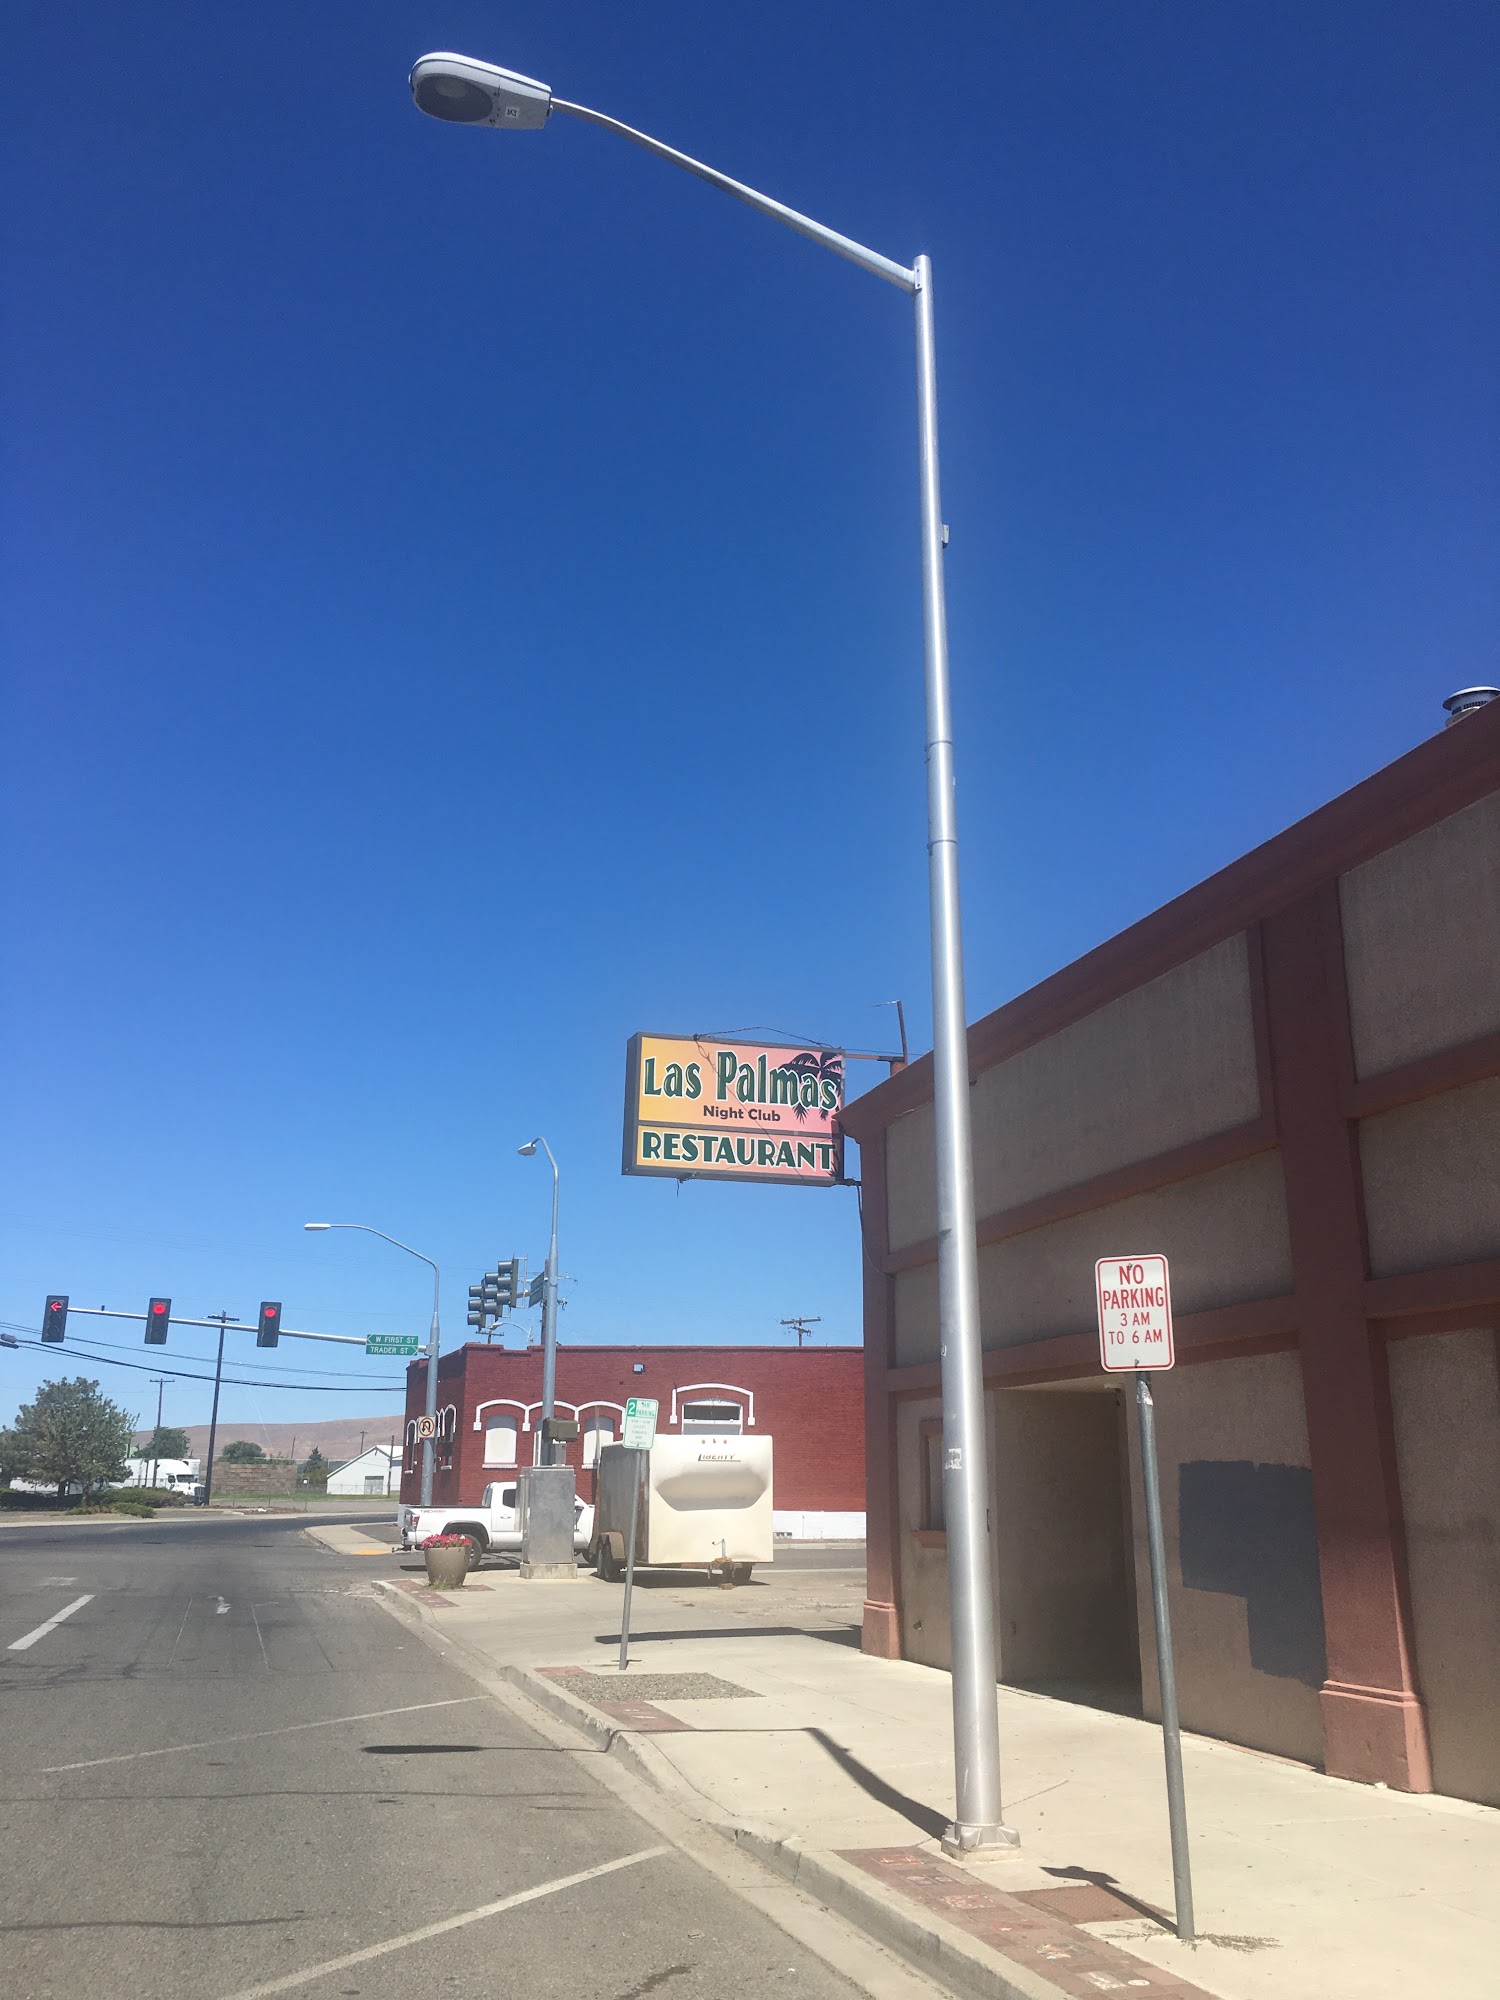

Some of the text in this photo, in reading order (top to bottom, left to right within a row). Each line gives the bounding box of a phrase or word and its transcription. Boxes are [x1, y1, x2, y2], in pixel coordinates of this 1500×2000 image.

[643, 1050, 838, 1111] Las Palmas
[703, 1105, 780, 1122] Night Club
[641, 1131, 836, 1171] RESTAURANT
[1118, 1264, 1144, 1285] NO
[1103, 1287, 1164, 1310] PARKING
[1120, 1311, 1151, 1327] 3 AM
[1108, 1329, 1163, 1345] TO 6 AM
[370, 1346, 397, 1354] TRADER
[628, 1402, 636, 1415] 2
[697, 1453, 736, 1461] LIBERTY
